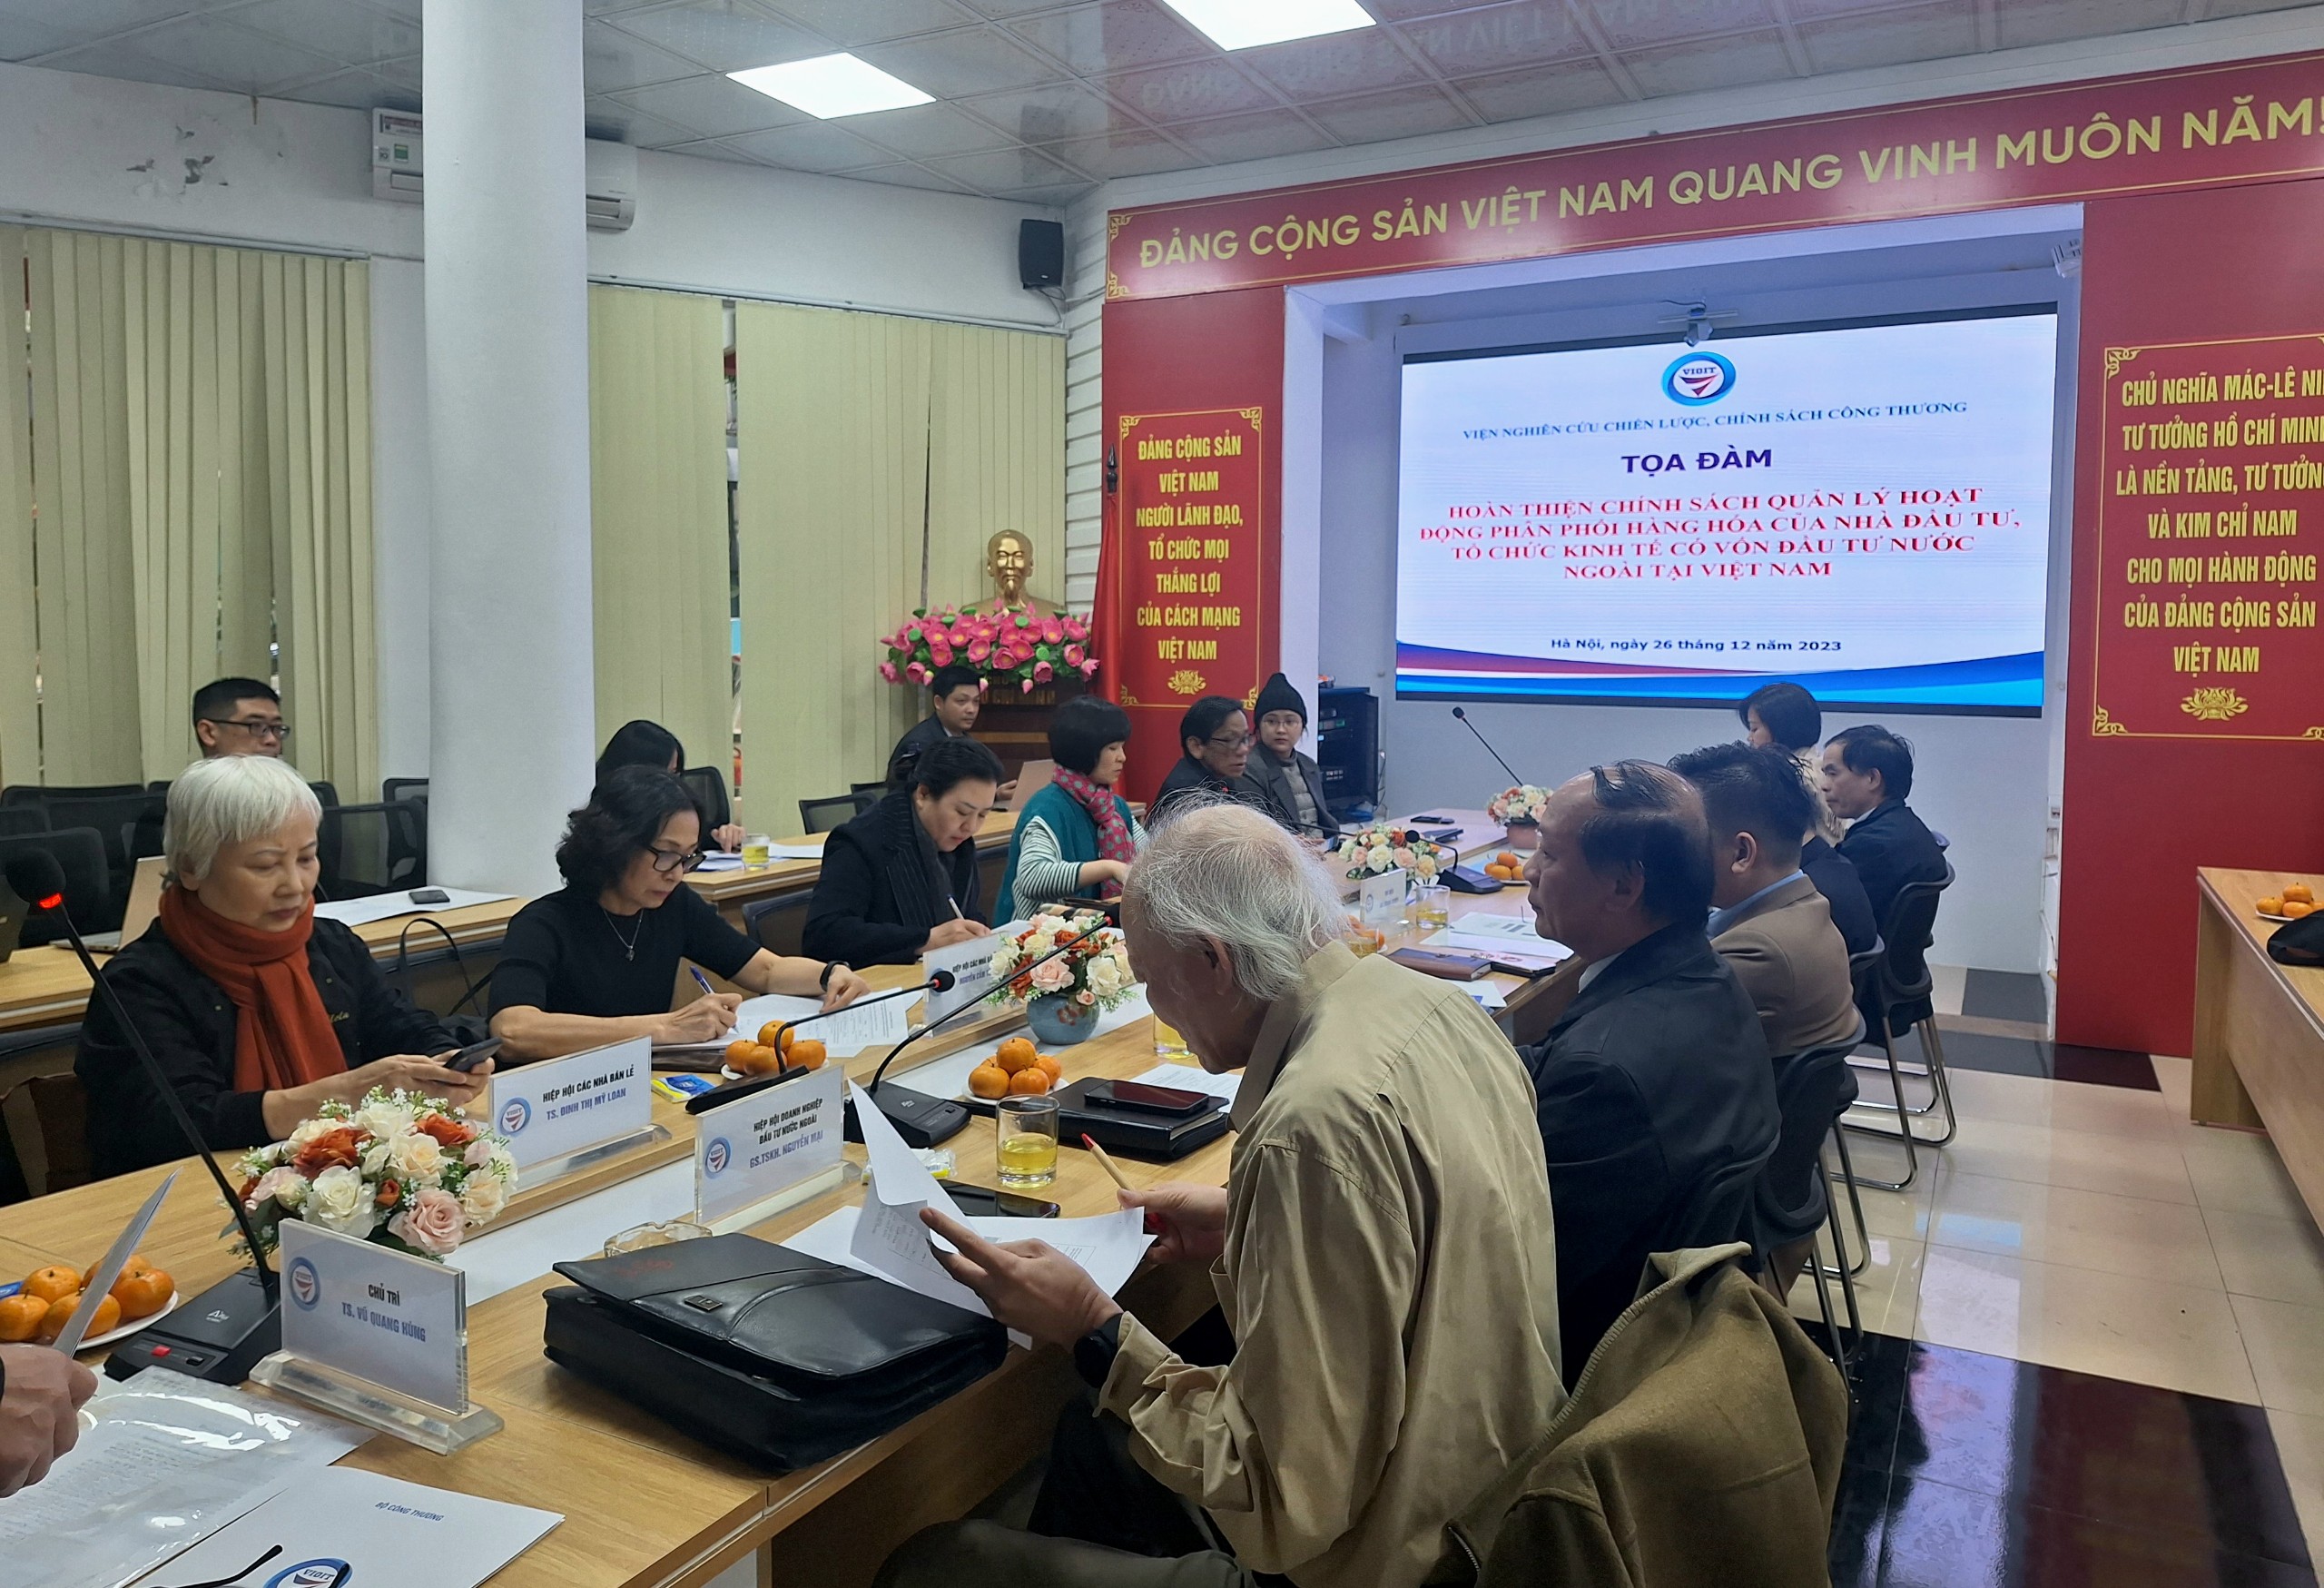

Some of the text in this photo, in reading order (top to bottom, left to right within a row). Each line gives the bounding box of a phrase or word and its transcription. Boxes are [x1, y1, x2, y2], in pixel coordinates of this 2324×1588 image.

[1140, 226, 1239, 268] ĐẢNG
[1249, 215, 1360, 261] CỘNG
[1372, 198, 1447, 241] SẢN
[1462, 186, 1545, 233] VIỆT
[1559, 176, 1653, 219] NAM
[1669, 153, 1843, 204] QUANG
[1858, 137, 1976, 183] VINH
[1996, 112, 2161, 170] MUÔN
[2122, 365, 2324, 407] CHỦ NGHĨA MÁC-LÊ NI
[1463, 428, 1498, 441] VIỆN
[1502, 423, 1561, 438] NGHIÊN
[1566, 420, 1599, 434] CỨU
[1659, 415, 1710, 430] LƯỢC,
[1715, 411, 1770, 426] CHÍNH
[1776, 408, 1822, 422] SÁCH
[1828, 404, 1881, 419] CÔNG
[1886, 401, 1967, 417] THƯƠNG
[2122, 422, 2145, 450] TƯ
[2149, 415, 2207, 449] TƯỞNG
[2213, 411, 2238, 448] HỒ
[2244, 412, 2276, 446] CHÍ
[1138, 429, 1241, 462] ĐẢNG CỘNG SẢN
[1621, 445, 1771, 477] TỌA ĐÀM
[1159, 469, 1218, 497] VIỆT NAM
[2116, 454, 2324, 496] LÀ NỀN TẢNG, TƯ TƯỞN
[1136, 502, 1243, 528] NGƯỜI LÃNH ĐẠO,
[1449, 487, 1984, 519] HOÀN THIỆN CHÍNH SÁCH QUẢN LÝ HOẠT
[1420, 508, 2022, 543] ĐỘNG PHÂN PHỐI HÀNG HÓA CỦA NHÀ ĐẦU TƯ,
[2148, 502, 2297, 538] VÀ KIM CHỈ NAM
[1148, 533, 1229, 563] TỔ CHỨC MỌI
[1489, 541, 1555, 559] CHỨC
[1563, 544, 1624, 558] KINH
[1631, 538, 1663, 557] TẾ
[1669, 538, 1708, 557] CÓ
[1715, 537, 1769, 556] VỐN
[1778, 535, 1834, 554] ĐẦU
[1842, 535, 1886, 553] TƯ
[1889, 532, 1974, 552] NƯỚC
[1156, 567, 1221, 597] THẮNG LỢI
[1564, 560, 1833, 581] NGOÀI TẠI VIỆT NAM
[2127, 550, 2316, 588] CHO MỌI HÀNH ĐỘNG
[1137, 601, 1240, 630] CỦA CÁCH MẠNG
[2124, 592, 2316, 633] CỦA ĐẢNG CỘNG SẢN
[1157, 636, 1216, 664] VIỆT NAM
[1551, 639, 1841, 652] Hà Nội, ngày 26 tháng 12 năm 2023
[2173, 641, 2260, 678] VIỆT NAM
[543, 1064, 635, 1103] HIỆP HỘI CÁC NHÀ BÁN LẺ
[547, 1110, 559, 1120] TS.
[581, 1098, 593, 1110] THỊ
[607, 1088, 626, 1102] LOAN
[769, 1113, 780, 1127] HỘI
[781, 1106, 801, 1122] DOANH
[799, 1113, 818, 1129] NGOÀI
[750, 1148, 782, 1169] GS.TSKH.
[811, 1129, 823, 1143] MẠI
[368, 1282, 385, 1301] CHỦ
[341, 1301, 355, 1317] TS.
[370, 1311, 399, 1333] QUANG
[374, 1501, 389, 1511] BỘ
[388, 1503, 410, 1514] CÔNG
